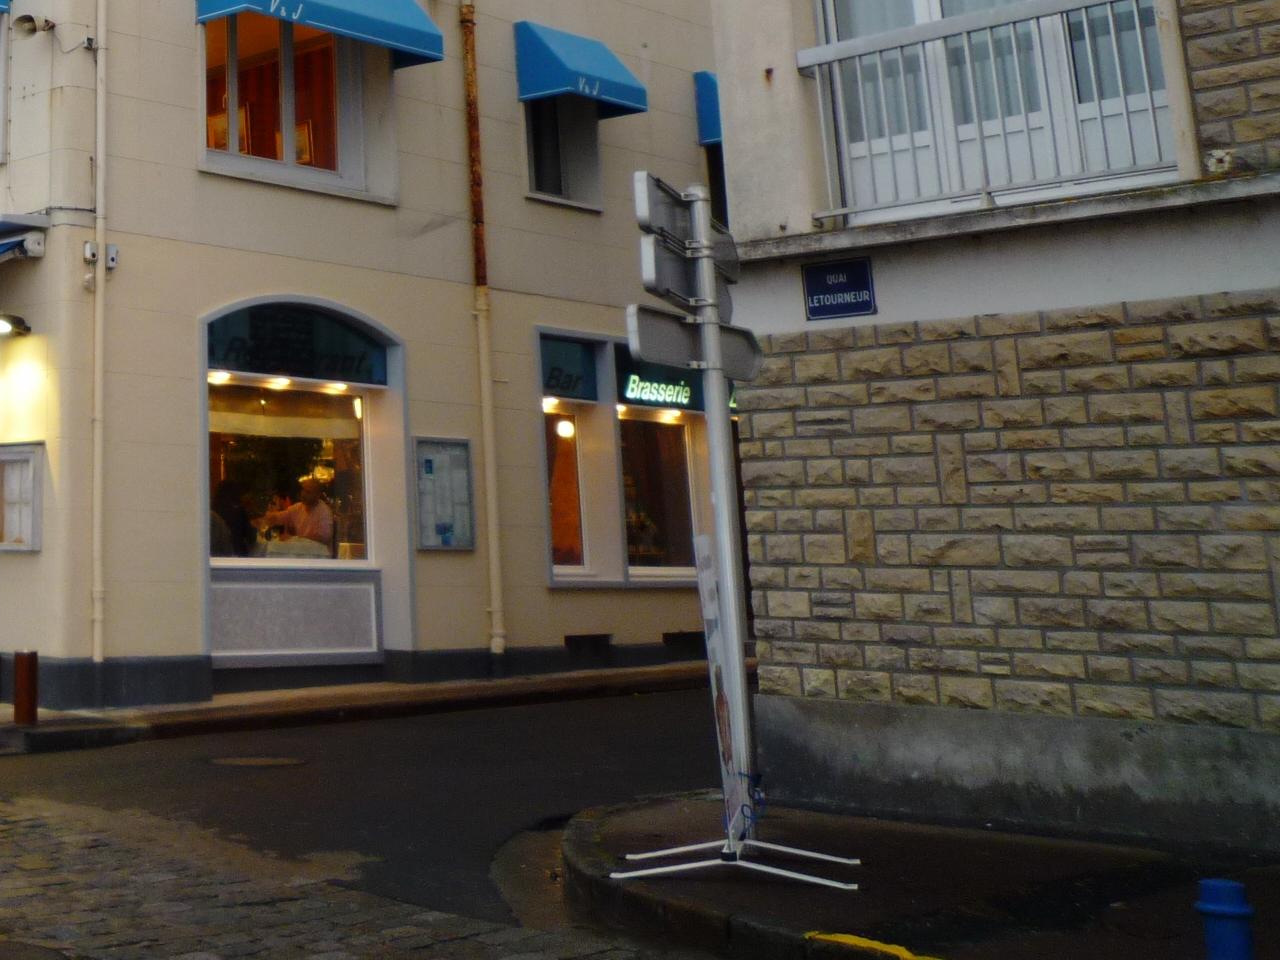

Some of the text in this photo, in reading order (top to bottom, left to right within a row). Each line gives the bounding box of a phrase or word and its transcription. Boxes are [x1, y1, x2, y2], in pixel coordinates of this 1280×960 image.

[826, 272, 847, 284] QUAI
[808, 289, 870, 307] LETOURNEUR
[546, 367, 584, 391] Bar
[626, 373, 691, 404] Brasserie
